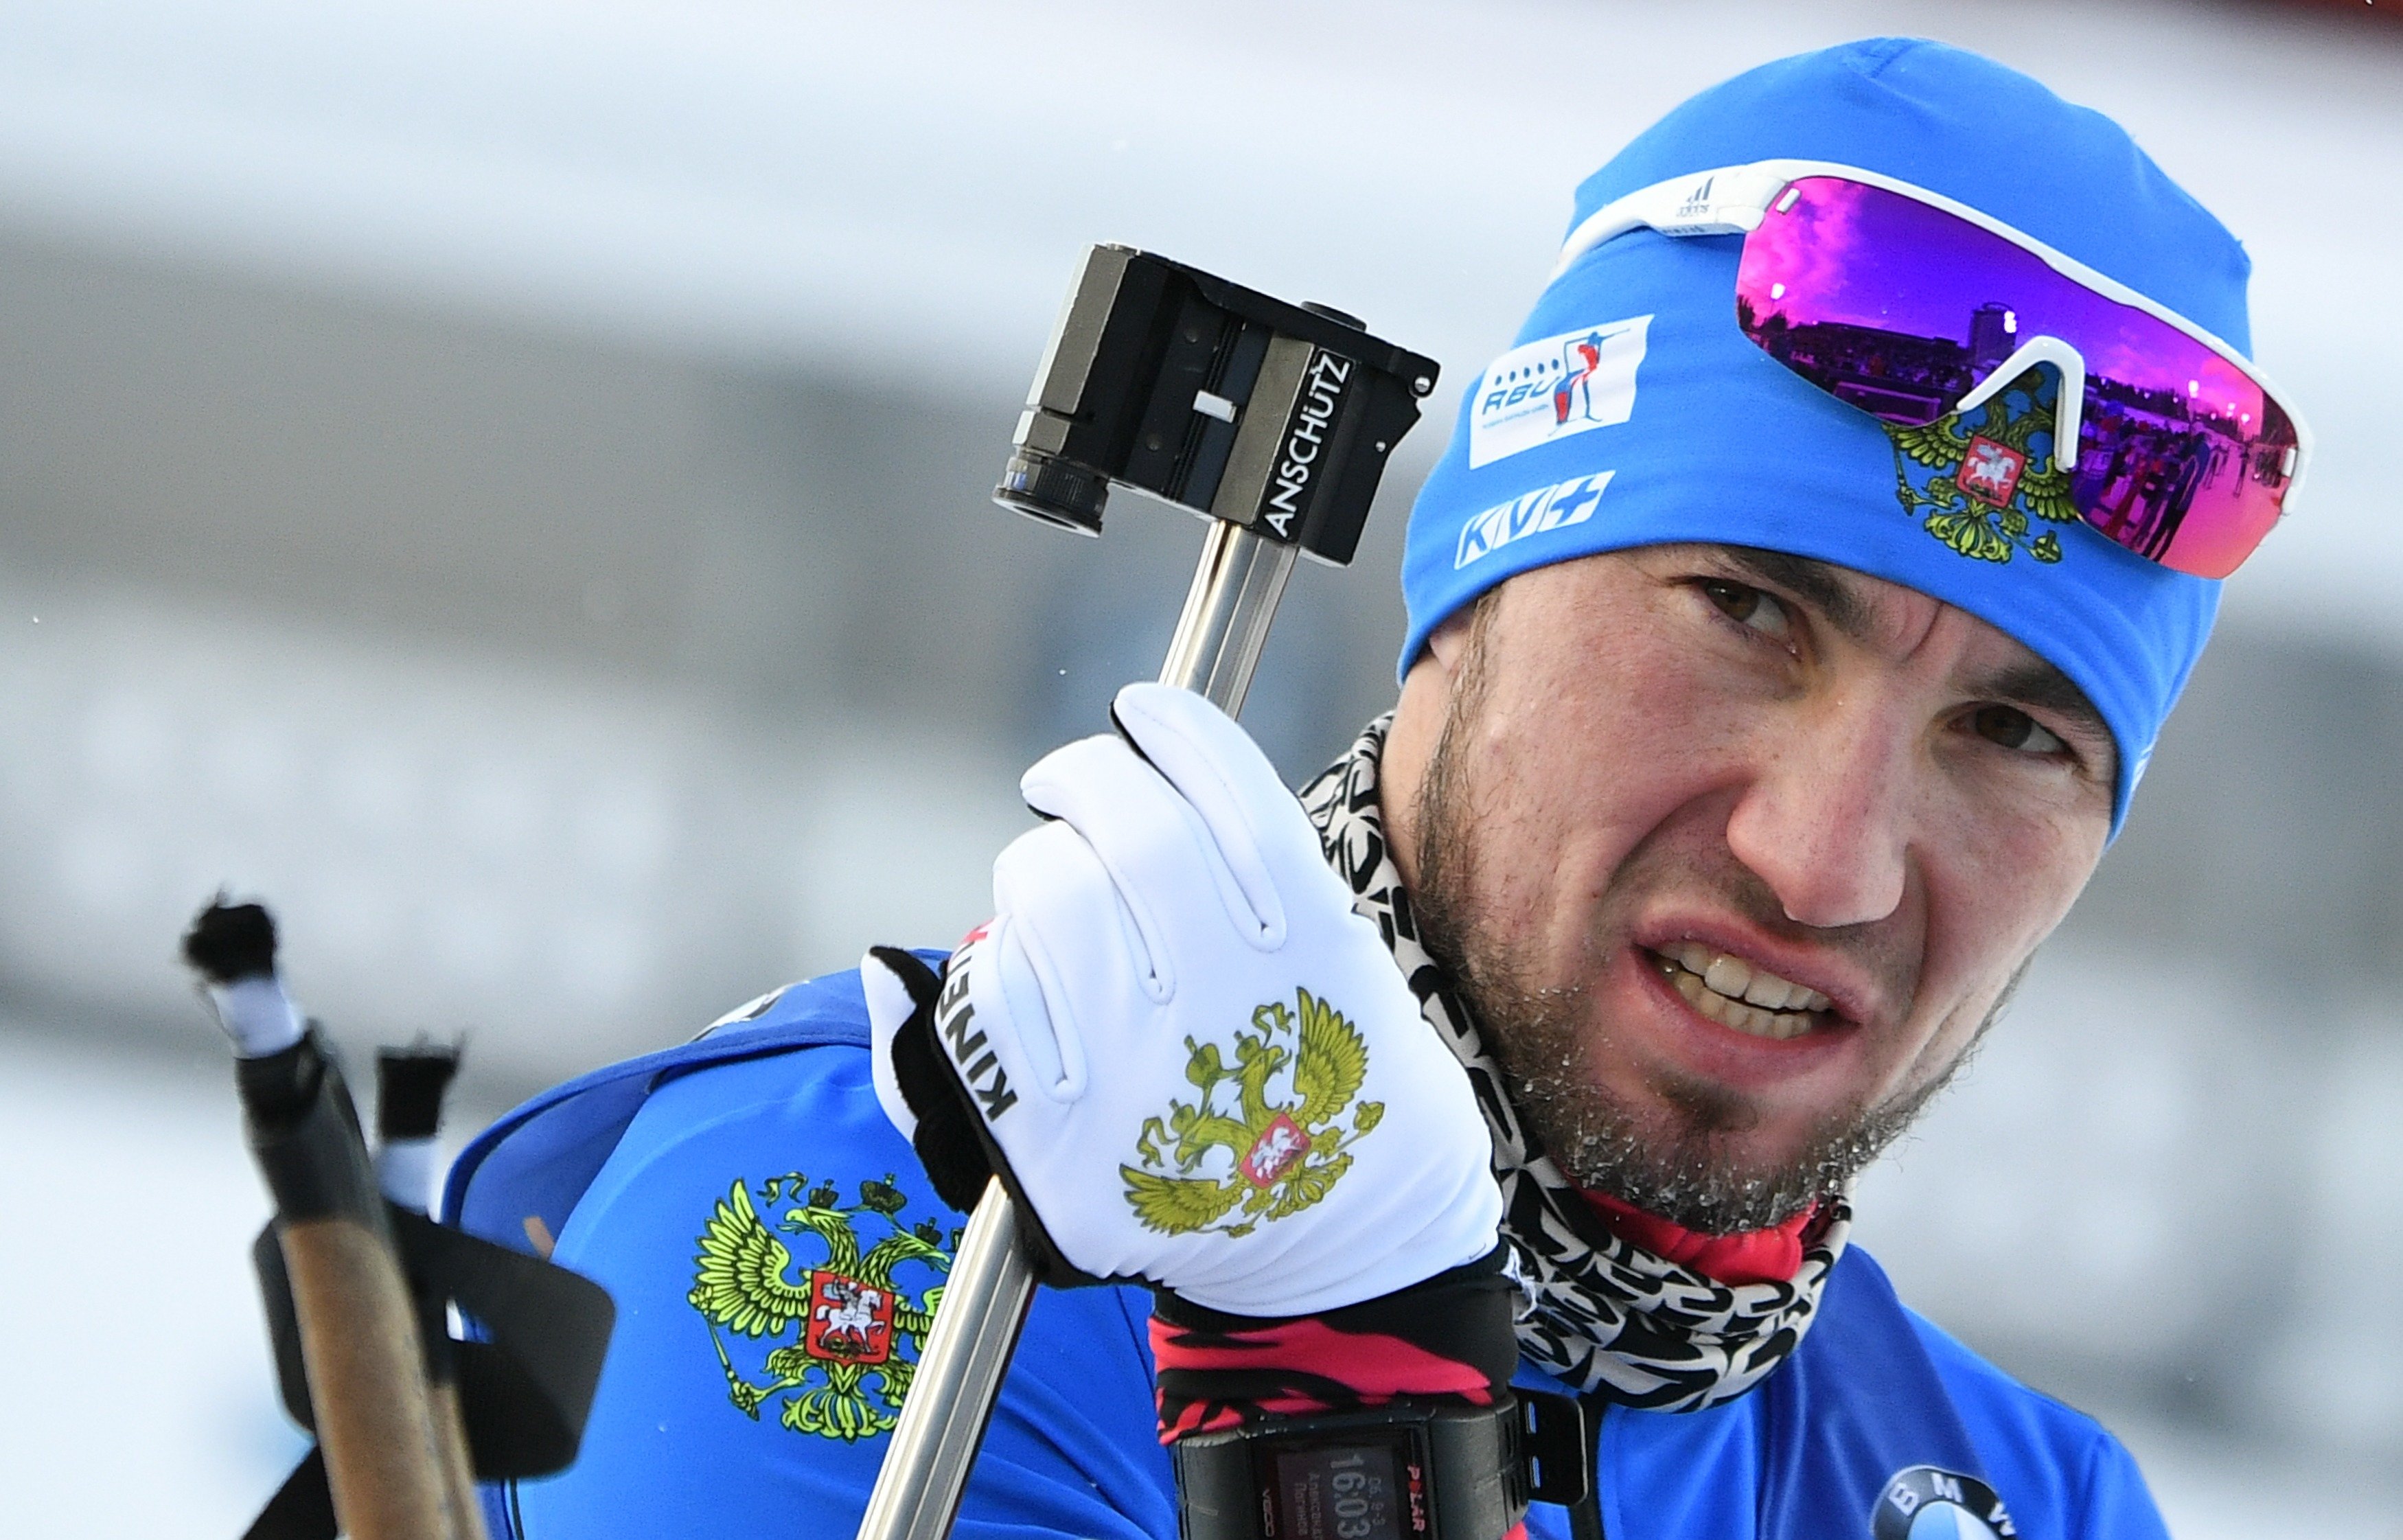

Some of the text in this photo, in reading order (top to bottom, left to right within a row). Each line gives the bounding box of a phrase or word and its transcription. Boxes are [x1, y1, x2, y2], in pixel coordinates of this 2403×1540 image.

[1482, 376, 1561, 416] RBU
[1265, 352, 1350, 538] ANSCHÜTZ
[1330, 1453, 1371, 1539] 16:03
[1407, 1464, 1425, 1532] POLAR
[1888, 1471, 2017, 1537] BMW
